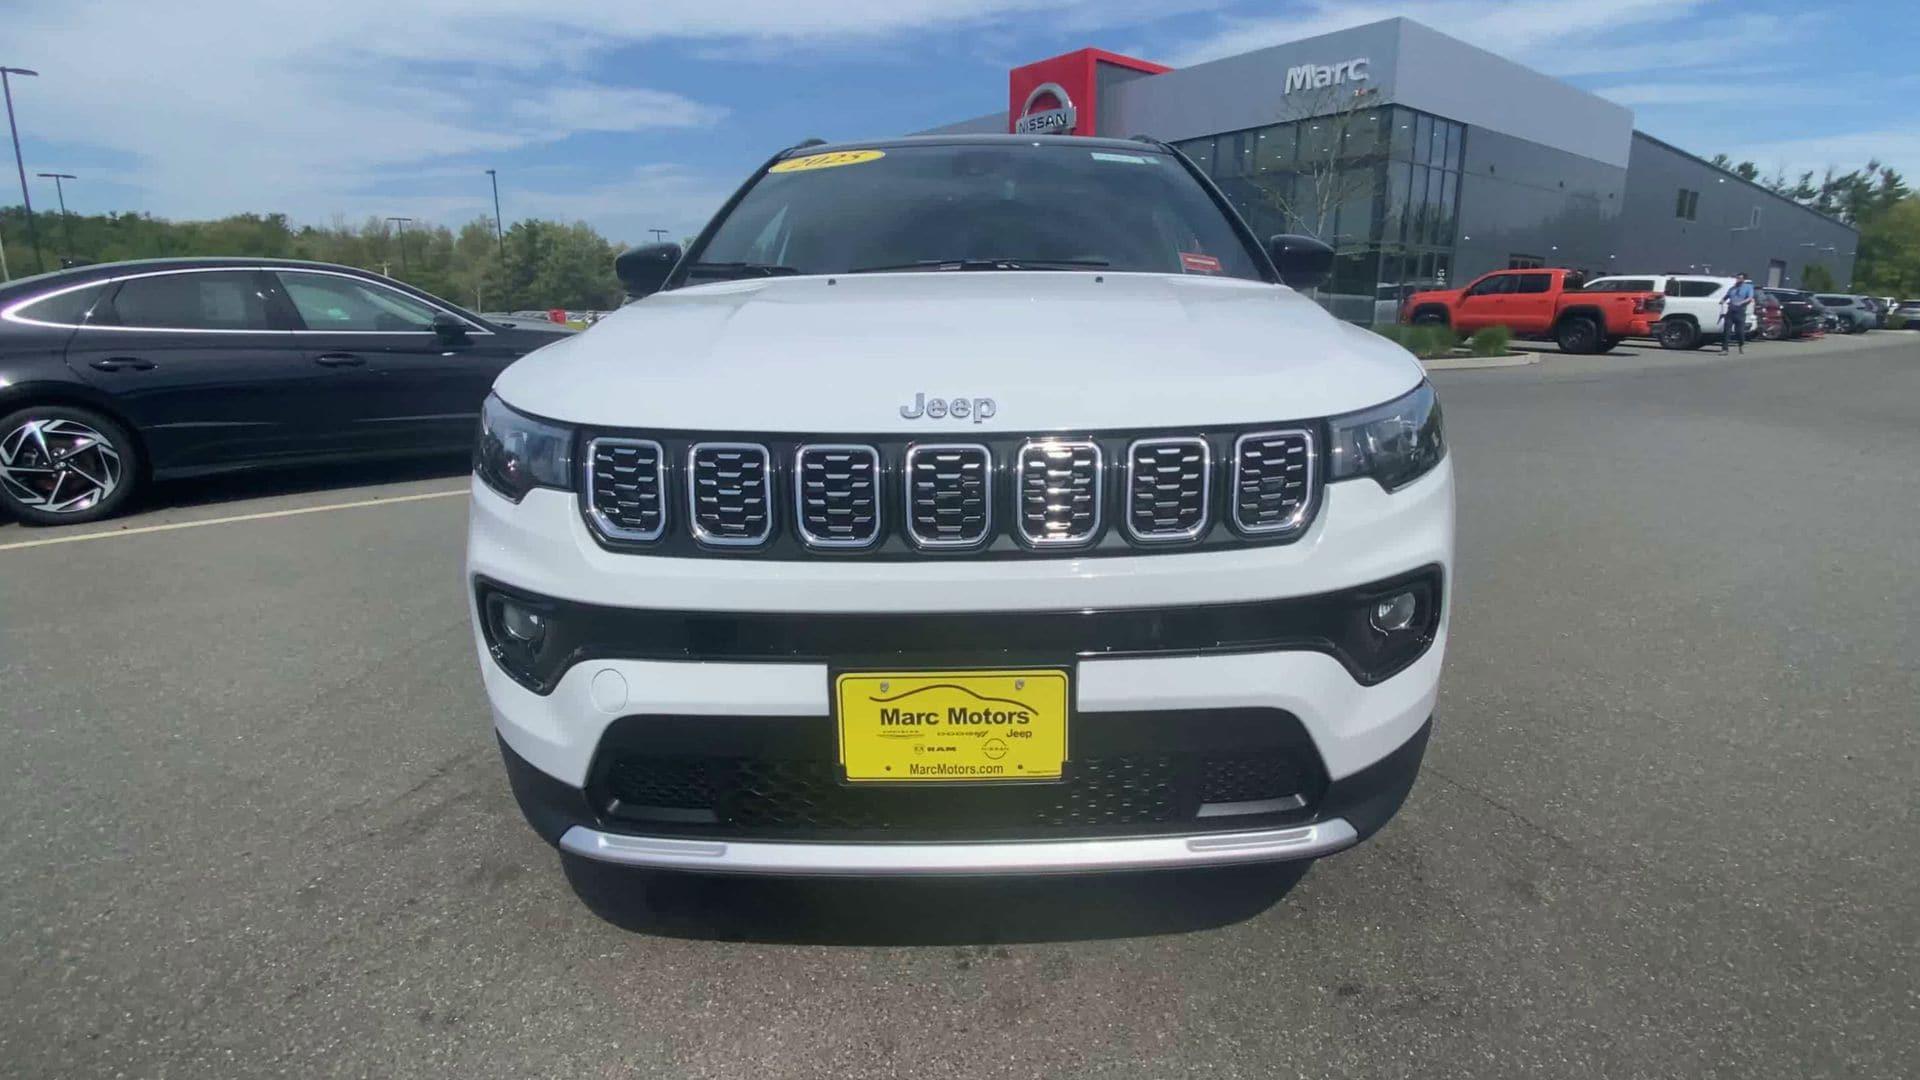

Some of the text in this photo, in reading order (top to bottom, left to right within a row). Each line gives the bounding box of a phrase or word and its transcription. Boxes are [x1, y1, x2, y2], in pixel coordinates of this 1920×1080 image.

[1284, 57, 1370, 95] Marc
[1017, 112, 1068, 134] NISSAN
[899, 392, 997, 424] Jeep
[880, 707, 1030, 726] Marc Motors
[1006, 729, 1032, 739] Jeep
[909, 763, 1004, 776] MarcMotors.com
